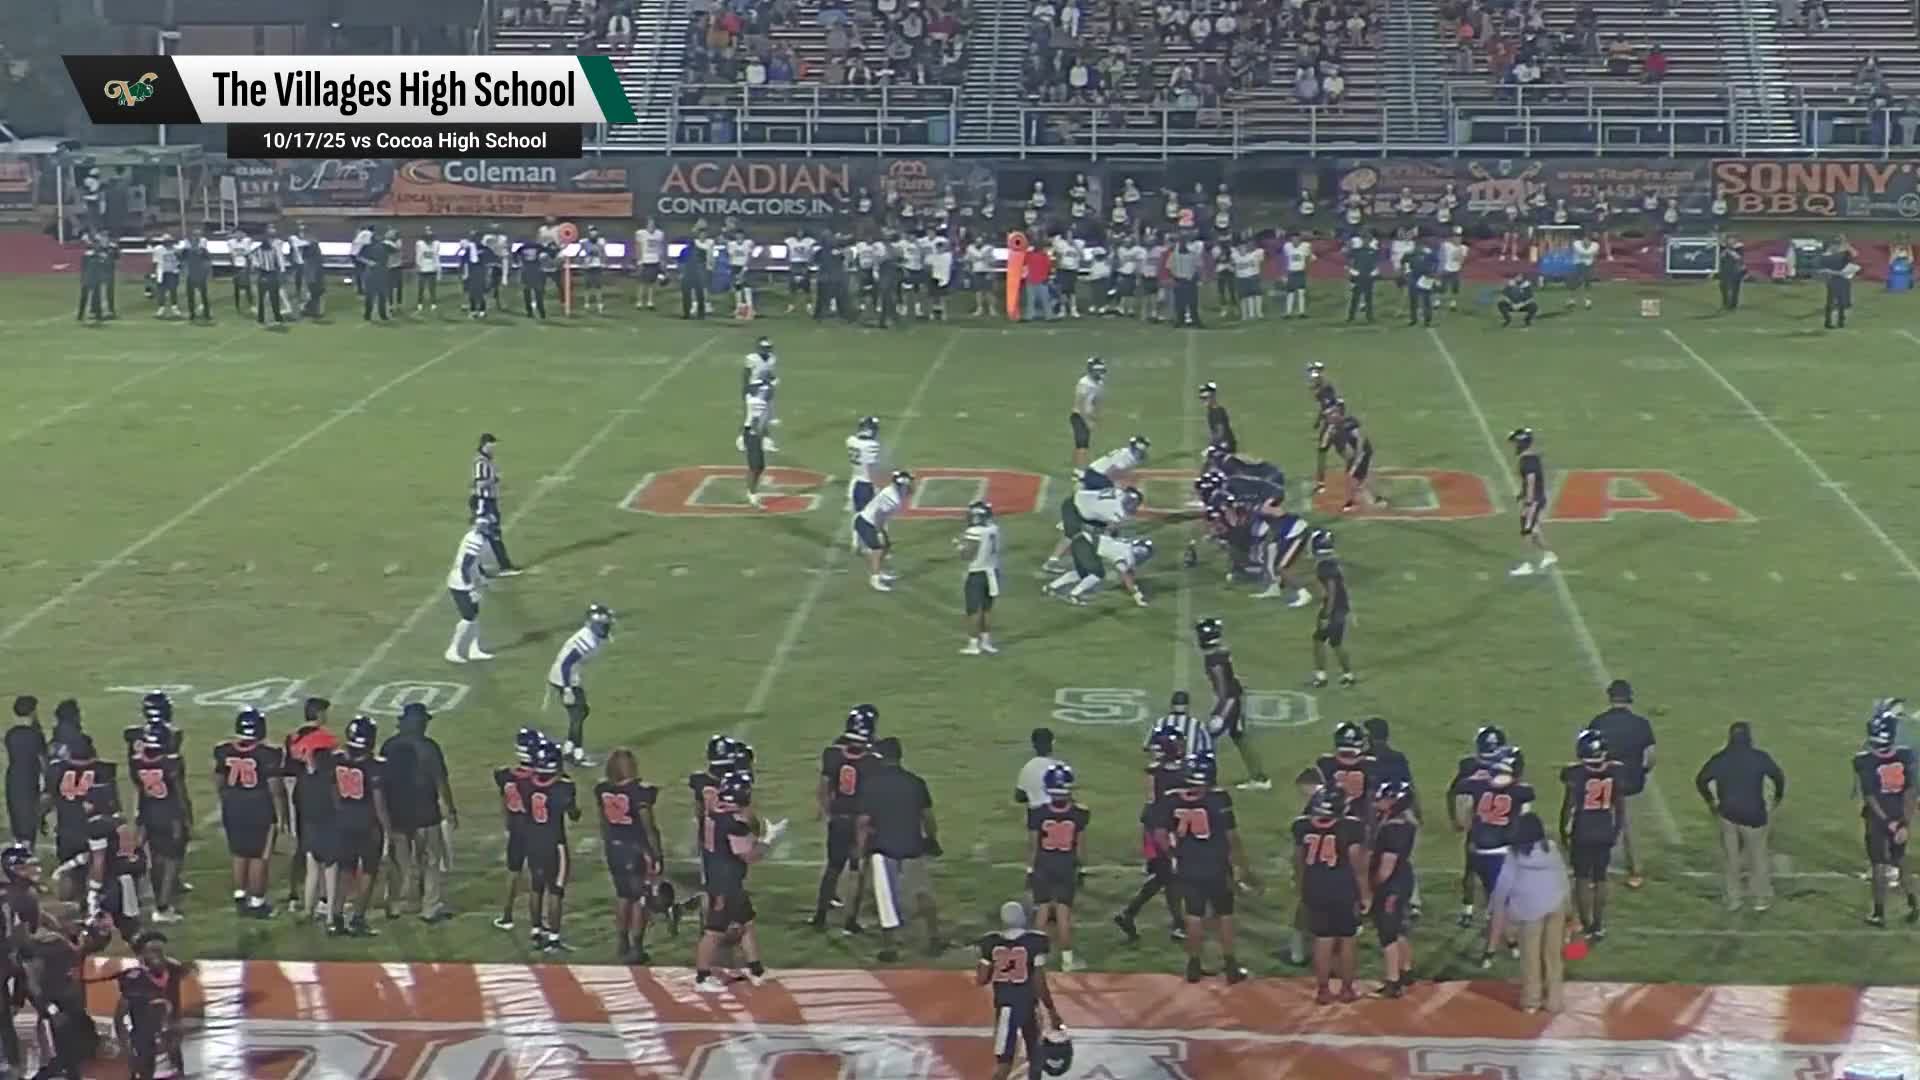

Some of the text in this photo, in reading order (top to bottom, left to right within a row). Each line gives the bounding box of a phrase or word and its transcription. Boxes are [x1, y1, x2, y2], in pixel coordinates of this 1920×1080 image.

[444, 160, 557, 183] Coleman
[660, 163, 849, 194] ACADIAN
[1736, 193, 1838, 217] BBQ
[60, 770, 95, 800] 44
[1583, 777, 1615, 810] 21
[1478, 791, 1512, 826] 42
[1303, 834, 1338, 867] 74
[992, 946, 1028, 983] 23
